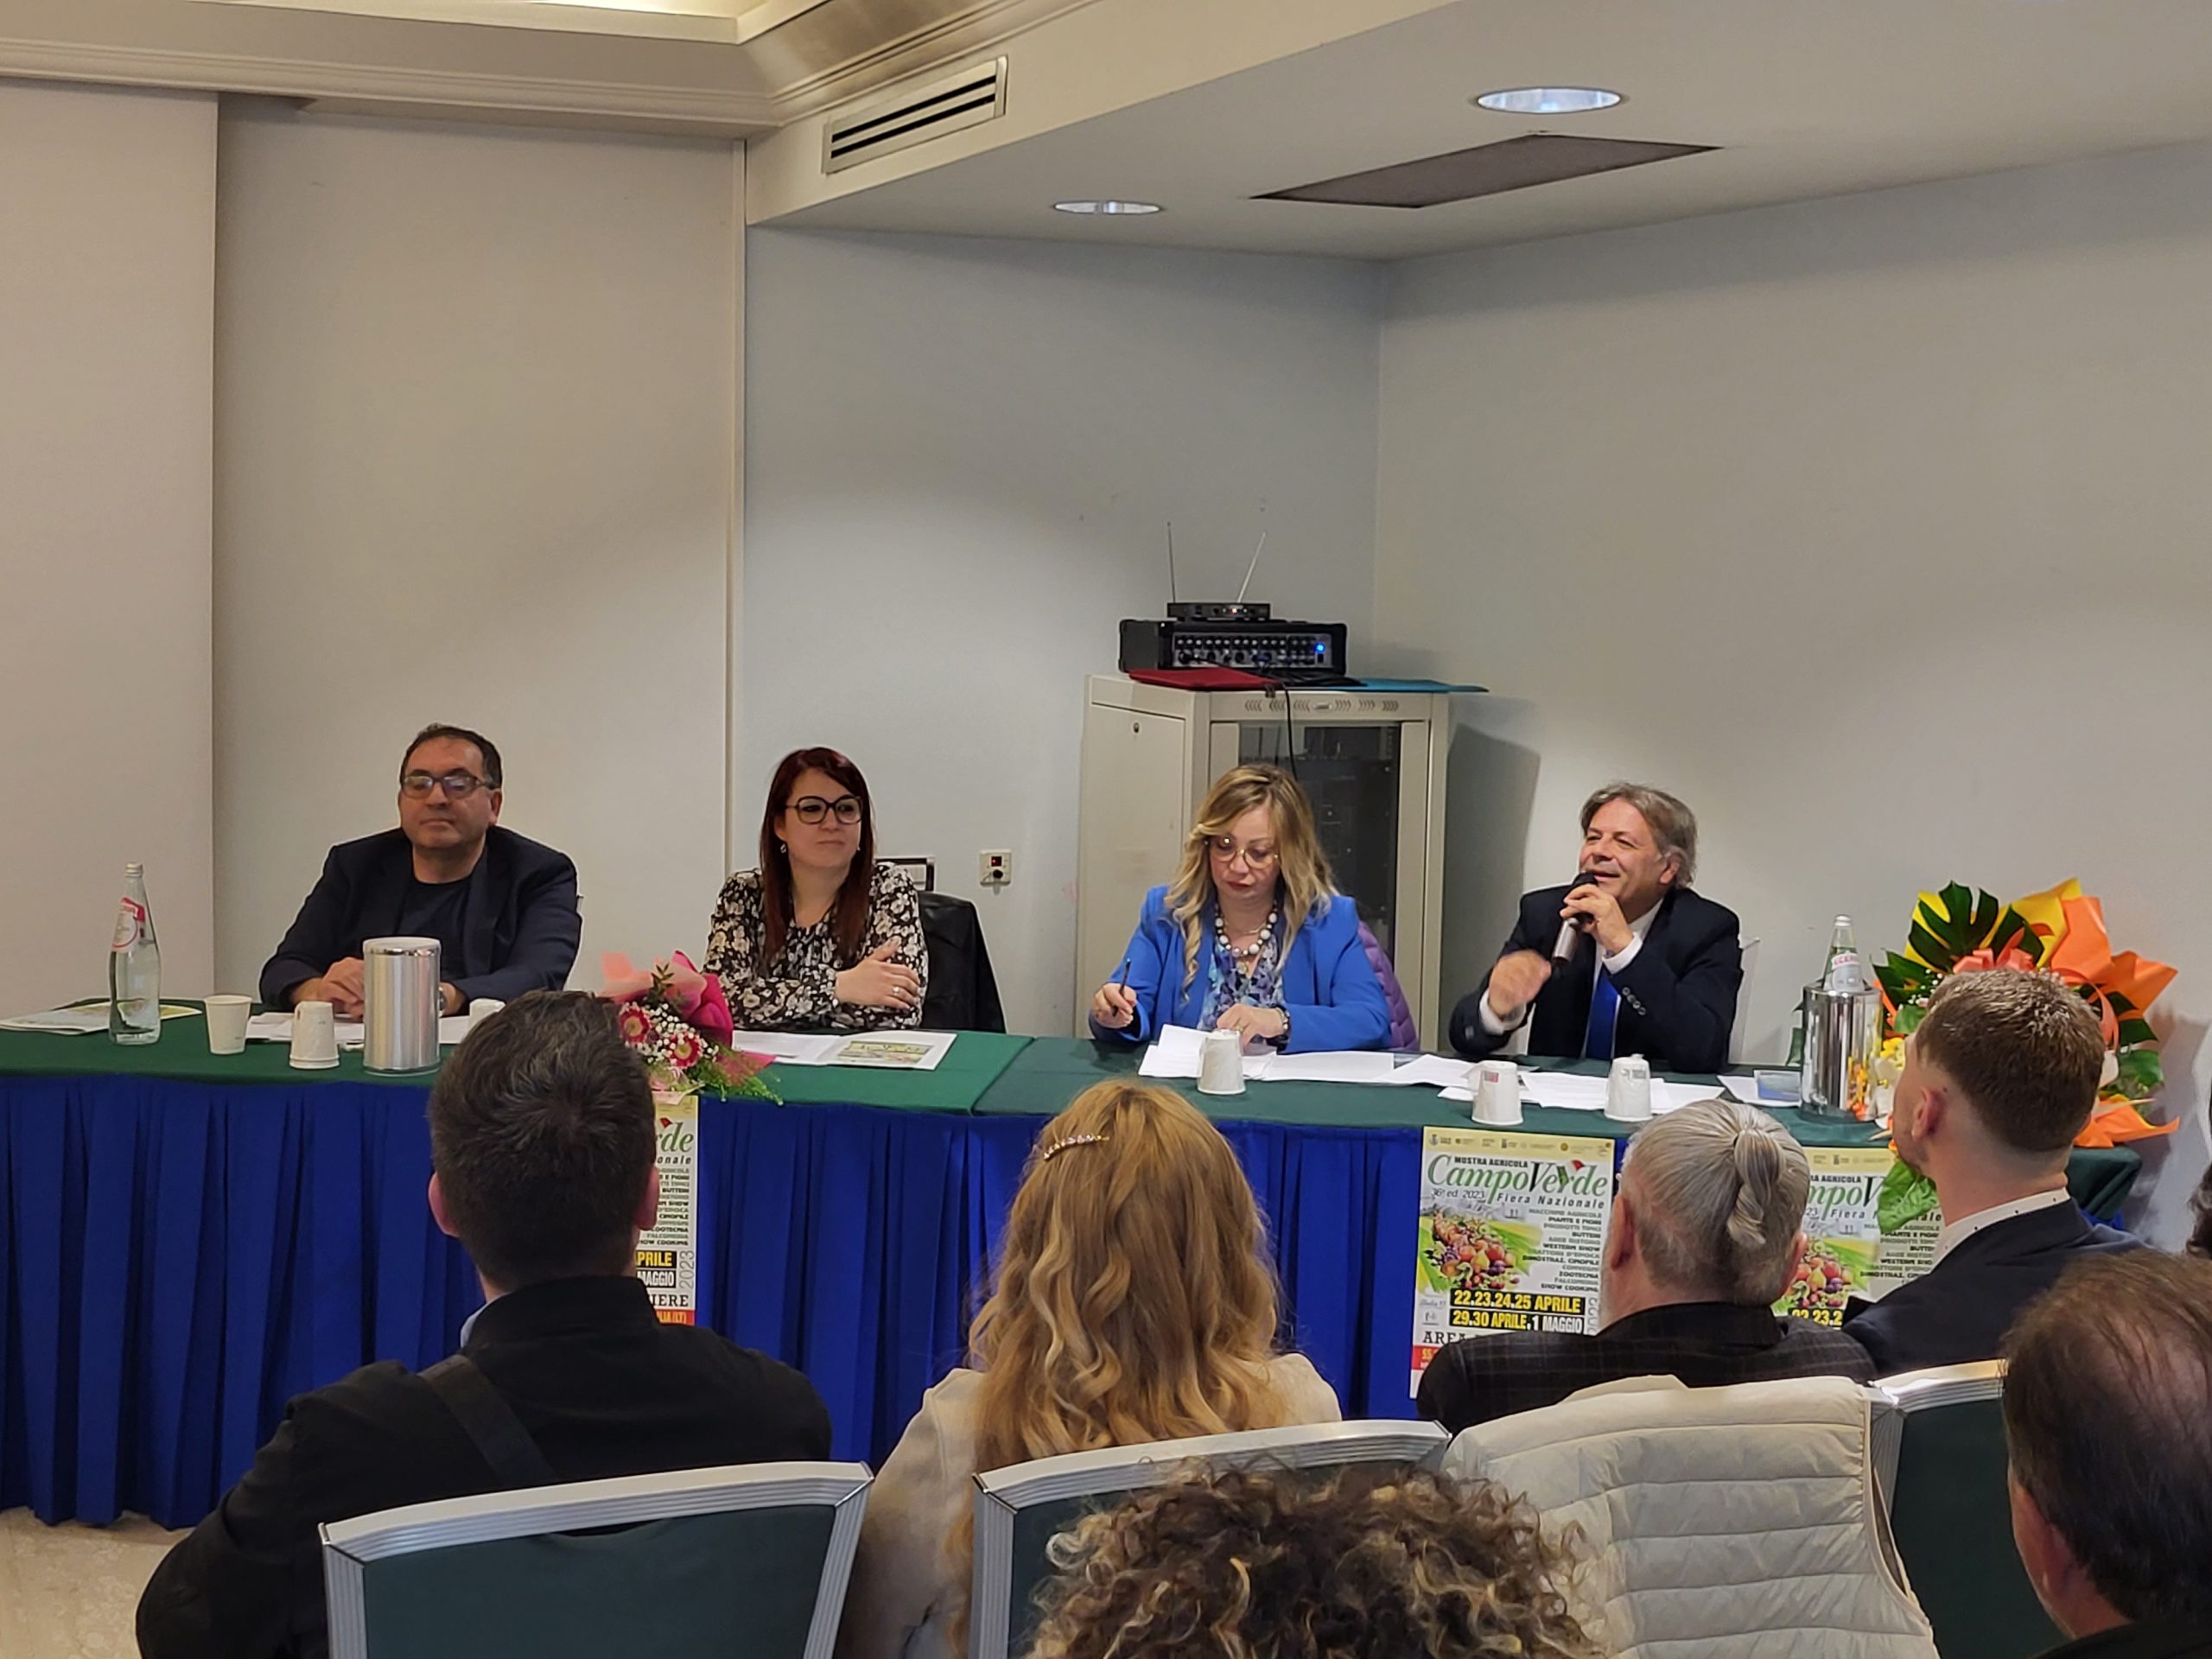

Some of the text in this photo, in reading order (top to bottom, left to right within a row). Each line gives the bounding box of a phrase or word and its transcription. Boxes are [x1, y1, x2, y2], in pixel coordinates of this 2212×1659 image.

[1454, 1156, 1528, 1168] MOSTRA AGRICOLA
[1497, 1193, 1605, 1210] Fiera Nazionale
[1831, 1210, 1865, 1219] Fiera
[637, 1251, 672, 1267] PRILE
[679, 1250, 695, 1289] 2023
[1453, 1290, 1532, 1310] 22.23.24.25
[1535, 1295, 1580, 1313] APRILE
[1452, 1310, 1489, 1327] 29.30
[1542, 1315, 1583, 1334] MAGGIO
